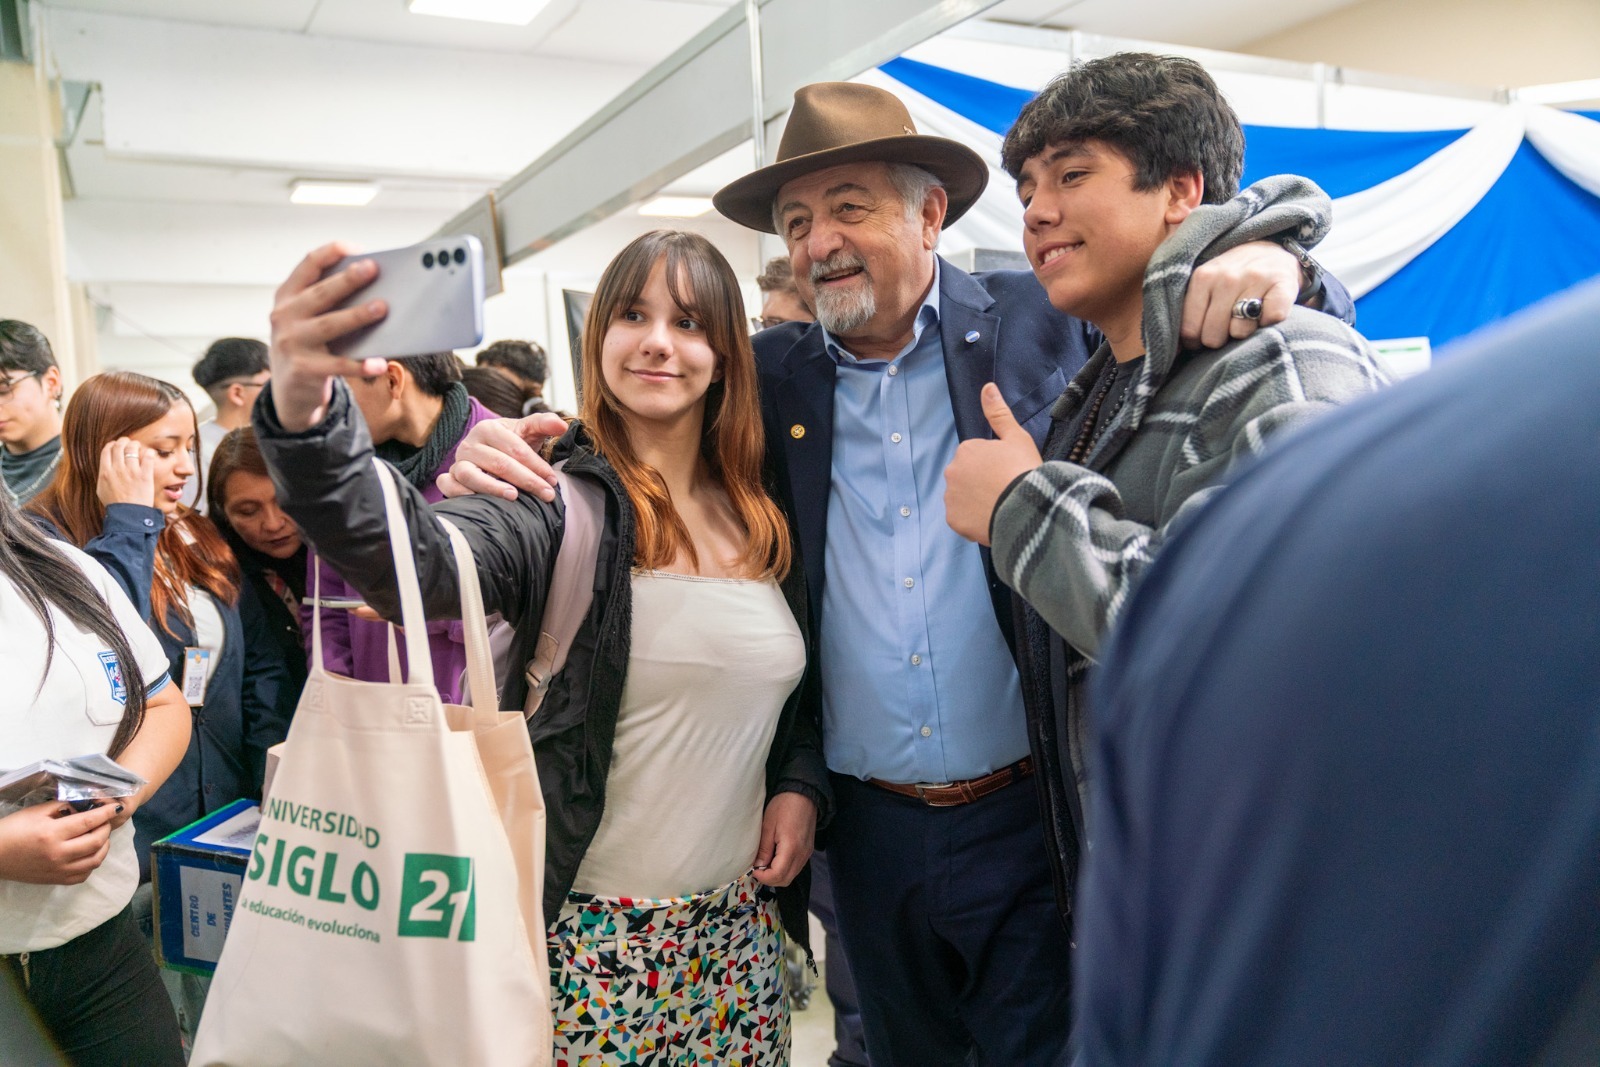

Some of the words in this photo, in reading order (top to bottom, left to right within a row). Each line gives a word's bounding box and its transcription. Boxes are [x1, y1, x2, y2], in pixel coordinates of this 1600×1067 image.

[247, 832, 380, 911] SIGLO
[189, 895, 200, 938] CENTRO
[206, 911, 217, 927] DE
[408, 858, 474, 941] 21
[249, 900, 305, 926] educación
[307, 919, 381, 944] evoluciona
